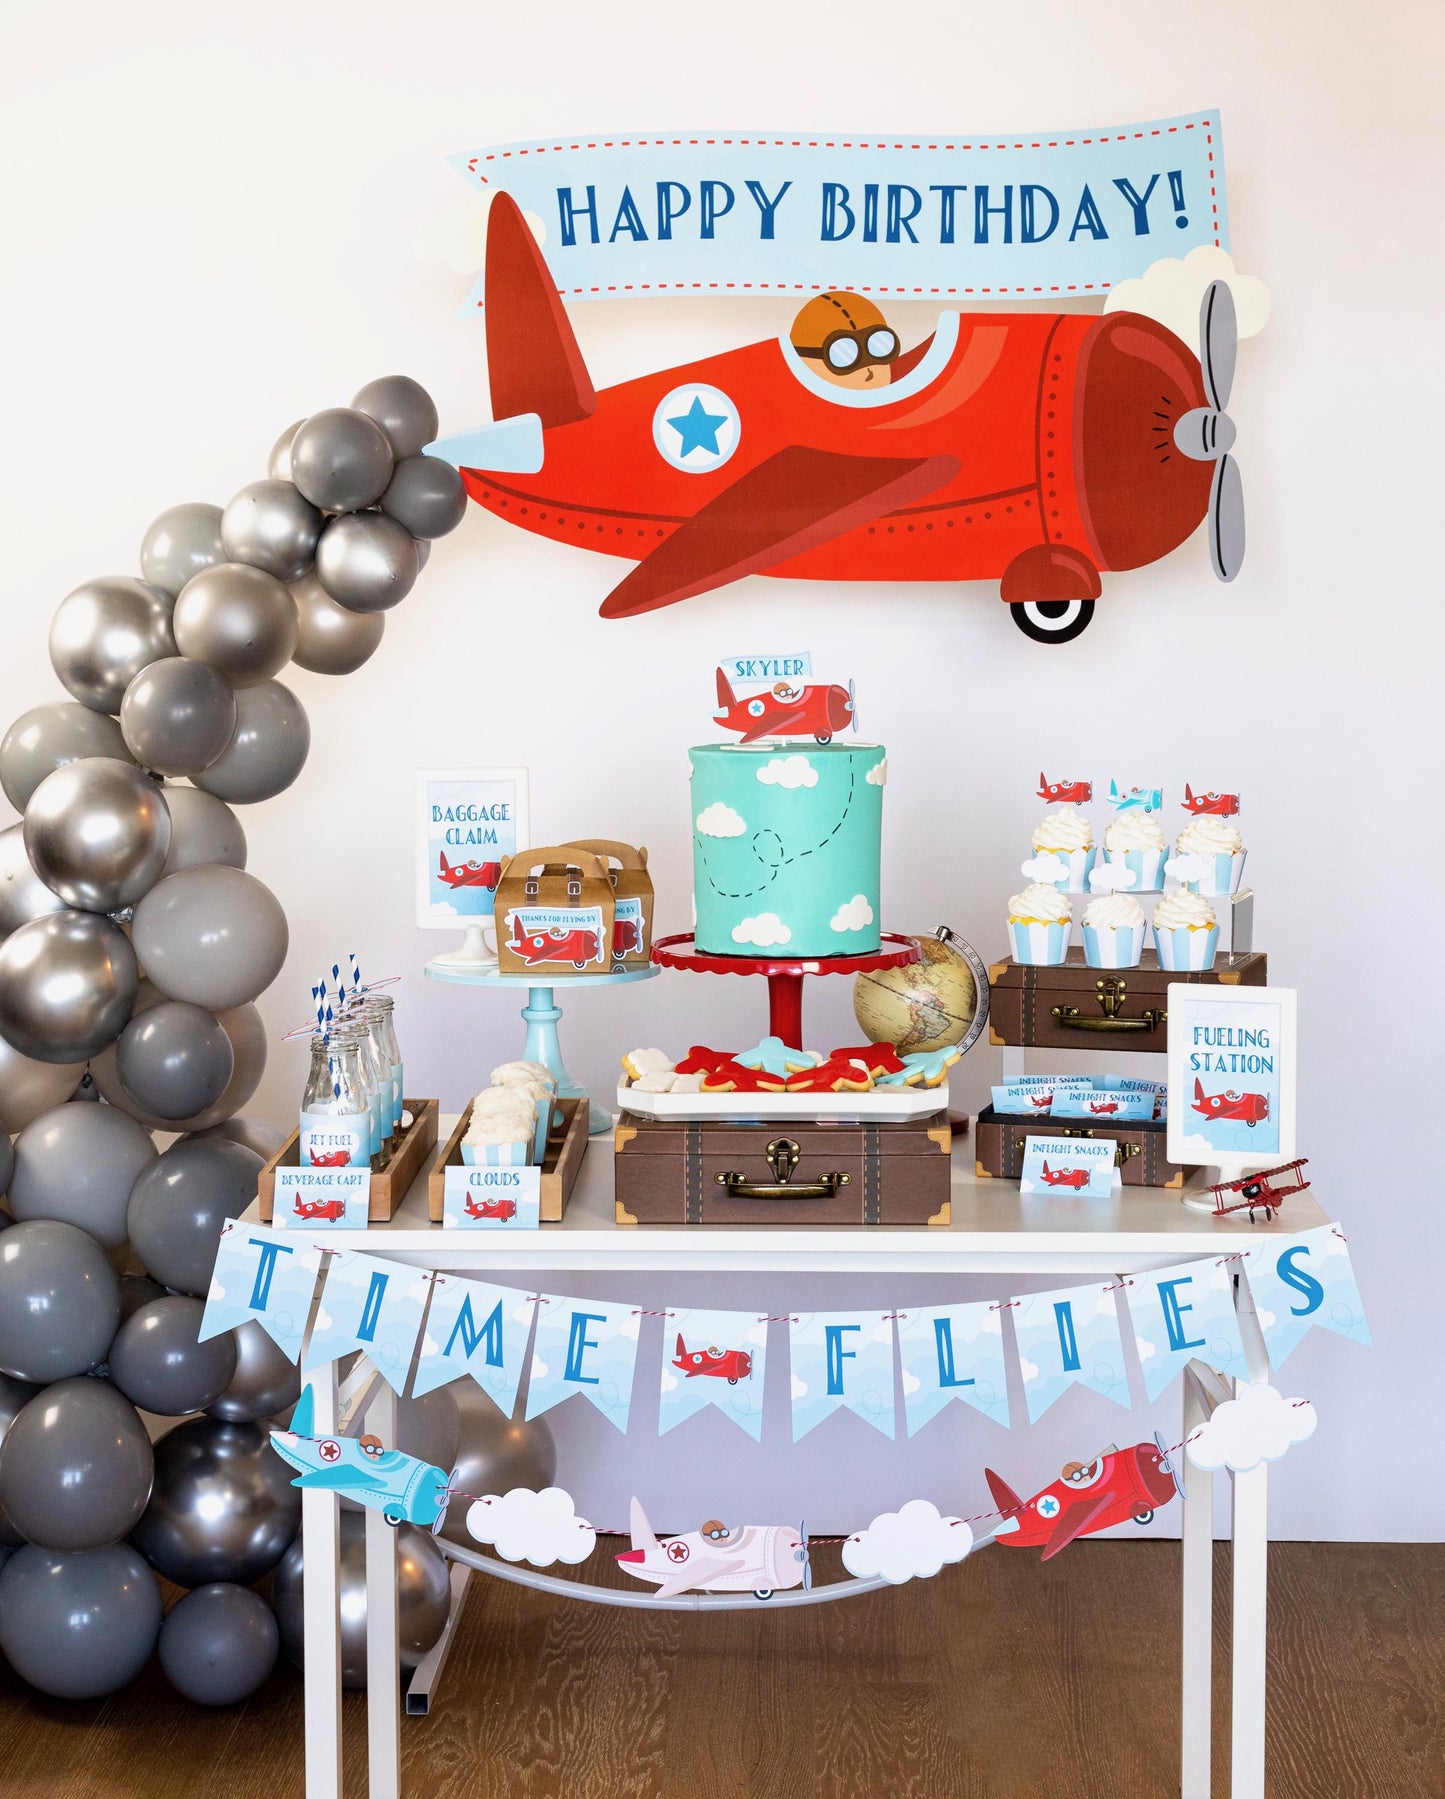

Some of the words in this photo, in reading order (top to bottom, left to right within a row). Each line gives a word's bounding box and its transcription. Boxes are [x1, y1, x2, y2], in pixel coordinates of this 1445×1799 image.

[556, 180, 793, 248] HAPPY
[820, 169, 1190, 245] BIRTHDAY!
[735, 659, 803, 677] SKYLER
[432, 803, 511, 822] BAGGAGE
[445, 827, 498, 845] CLAIM
[548, 915, 561, 923] FOR
[562, 915, 585, 923] FLYING
[1193, 1026, 1270, 1048] FUELING
[1190, 1052, 1274, 1074] STATION
[1019, 1077, 1056, 1085] INFLIGHT
[1120, 1079, 1156, 1093] INFLIGHT
[1007, 1086, 1045, 1097] INFLIGHT
[1069, 1092, 1107, 1101] INFLIGHT
[1109, 1093, 1142, 1103] SNACKS
[309, 1134, 325, 1145] JET
[328, 1134, 353, 1146] FUEL
[1032, 1143, 1073, 1155] INFLIGHT
[1075, 1145, 1109, 1156] SNACKS
[281, 1174, 335, 1186] BEVERAGE
[337, 1174, 364, 1186] CART
[469, 1172, 520, 1186] CLOUDS
